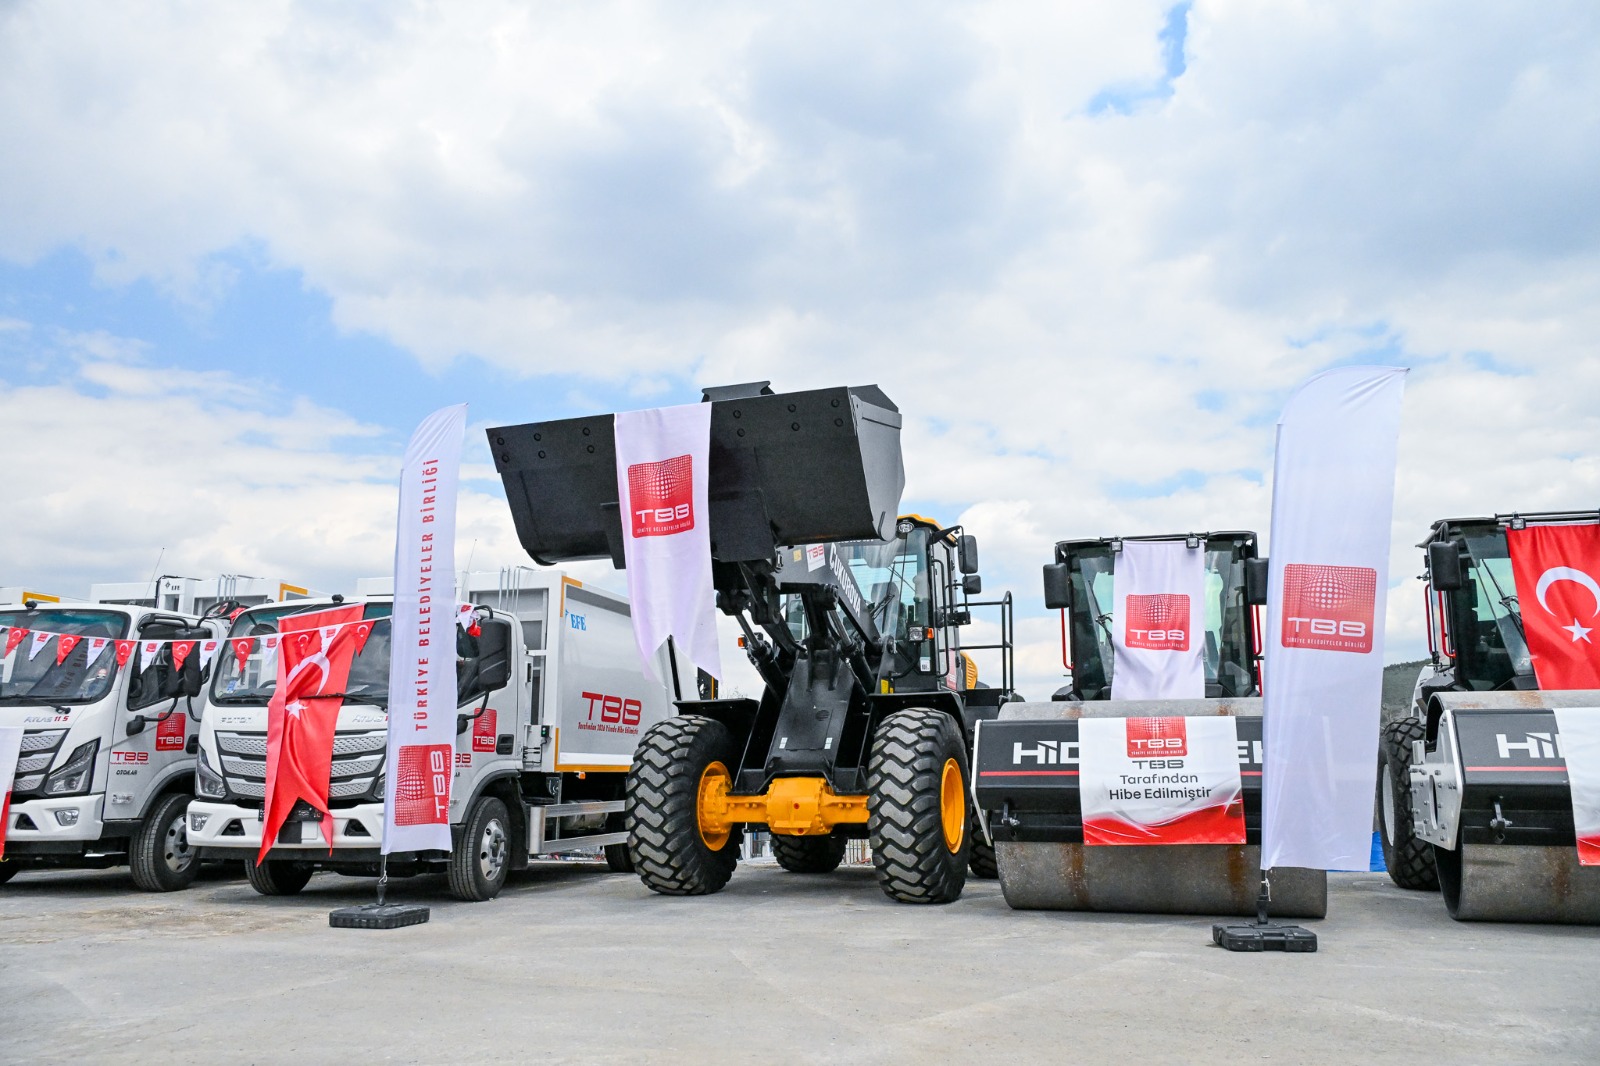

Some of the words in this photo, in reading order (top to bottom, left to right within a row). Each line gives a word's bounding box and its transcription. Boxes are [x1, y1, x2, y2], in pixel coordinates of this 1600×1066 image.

[420, 459, 438, 524] BİRLİĞİ
[636, 503, 690, 524] TBB
[418, 533, 434, 647] BELEDİYELER
[570, 614, 586, 631] EFE
[1288, 617, 1366, 637] TBB
[1130, 629, 1184, 640] TBB
[414, 657, 428, 731] TÜRKİYE
[582, 692, 642, 726] TBB
[158, 736, 183, 744] TBB
[474, 736, 494, 744] TBB
[1131, 738, 1182, 748] TBB
[112, 752, 148, 760] TBB
[1132, 760, 1184, 770] TBB
[430, 750, 446, 818] TBB
[1120, 773, 1198, 785] Tarafından
[1109, 788, 1142, 800] Hibe
[1144, 786, 1212, 800] Edilmiştir
